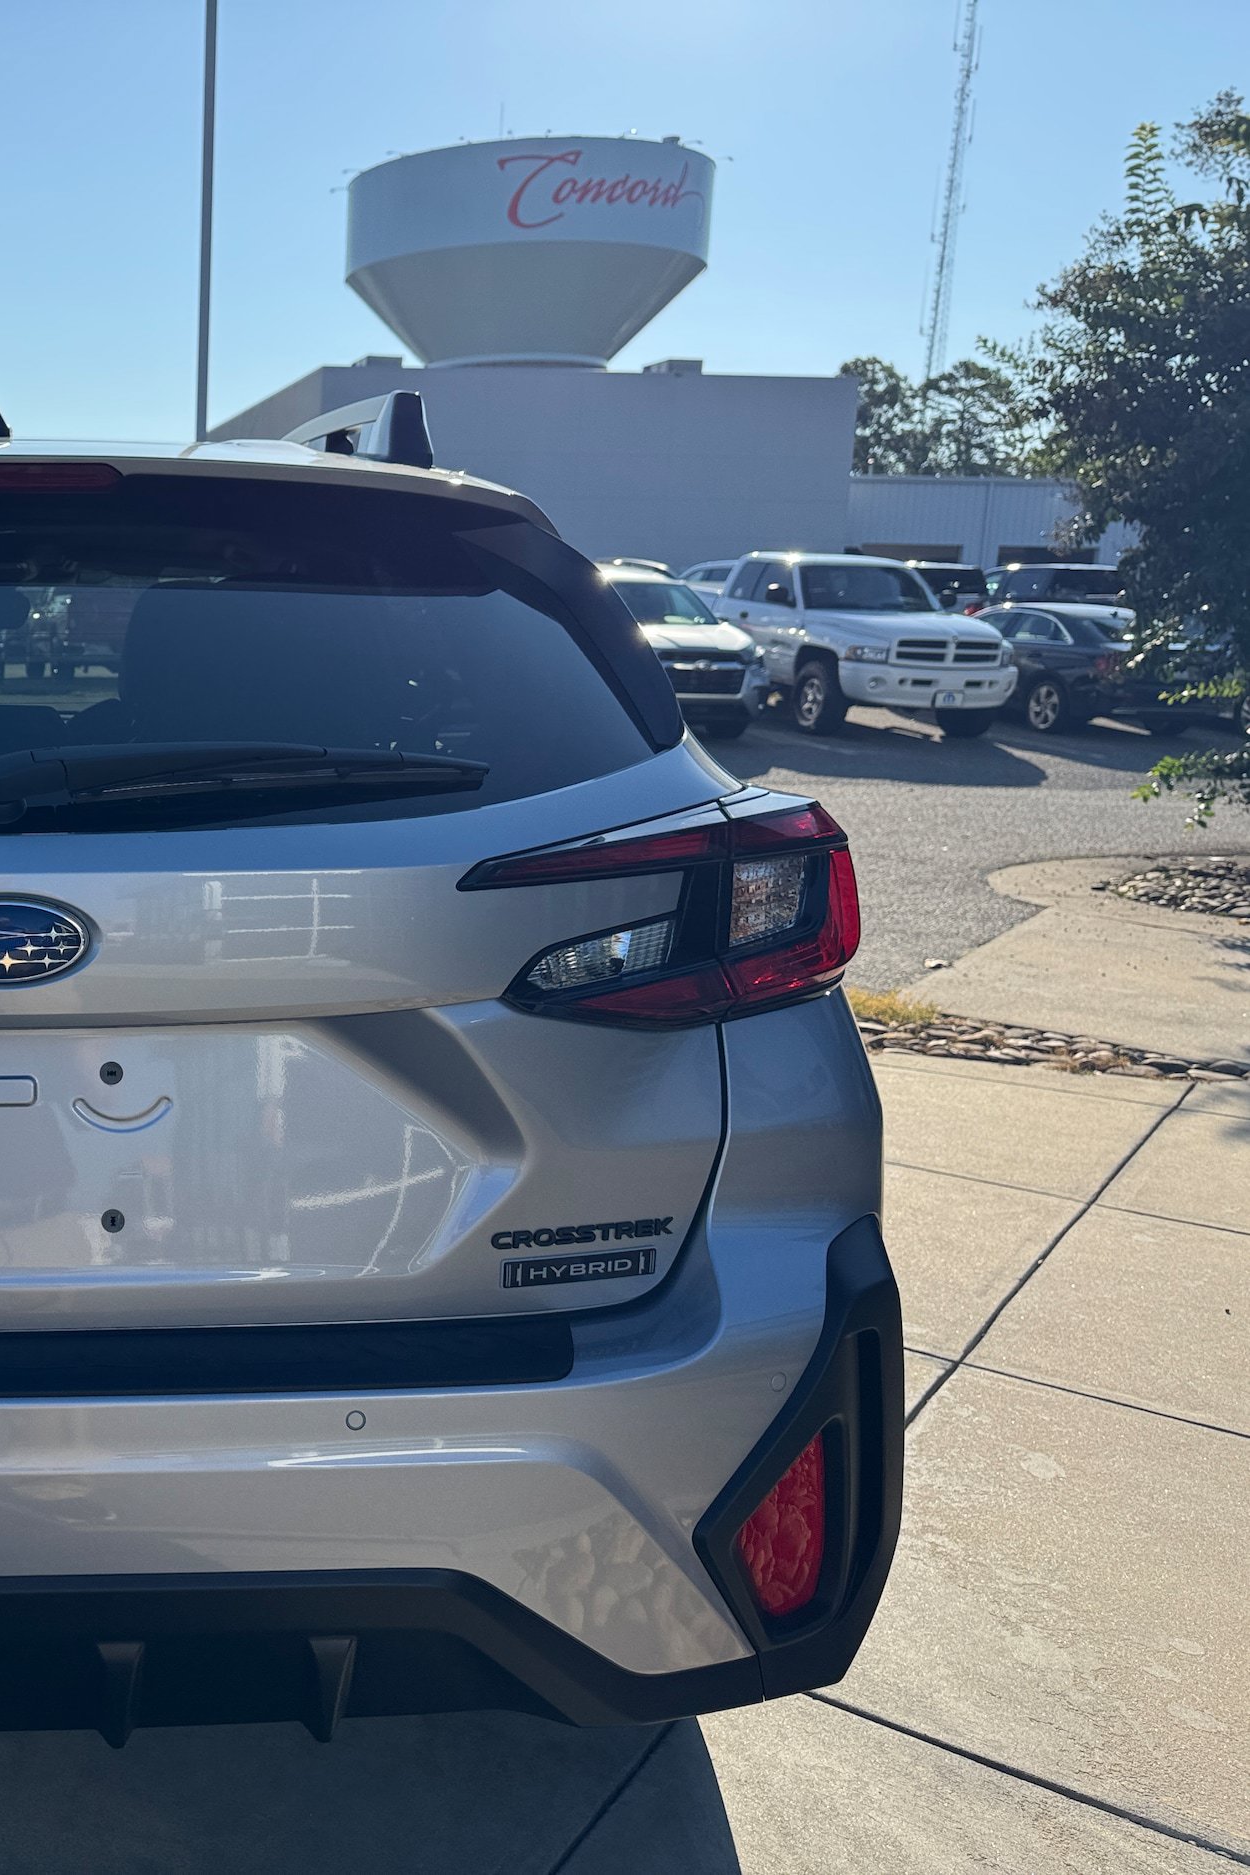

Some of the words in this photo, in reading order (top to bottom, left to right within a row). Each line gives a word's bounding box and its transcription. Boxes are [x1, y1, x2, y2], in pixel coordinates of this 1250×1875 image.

[496, 149, 703, 229] Concord
[490, 1216, 674, 1250] CROSSTREK
[529, 1259, 633, 1280] HYBRID
